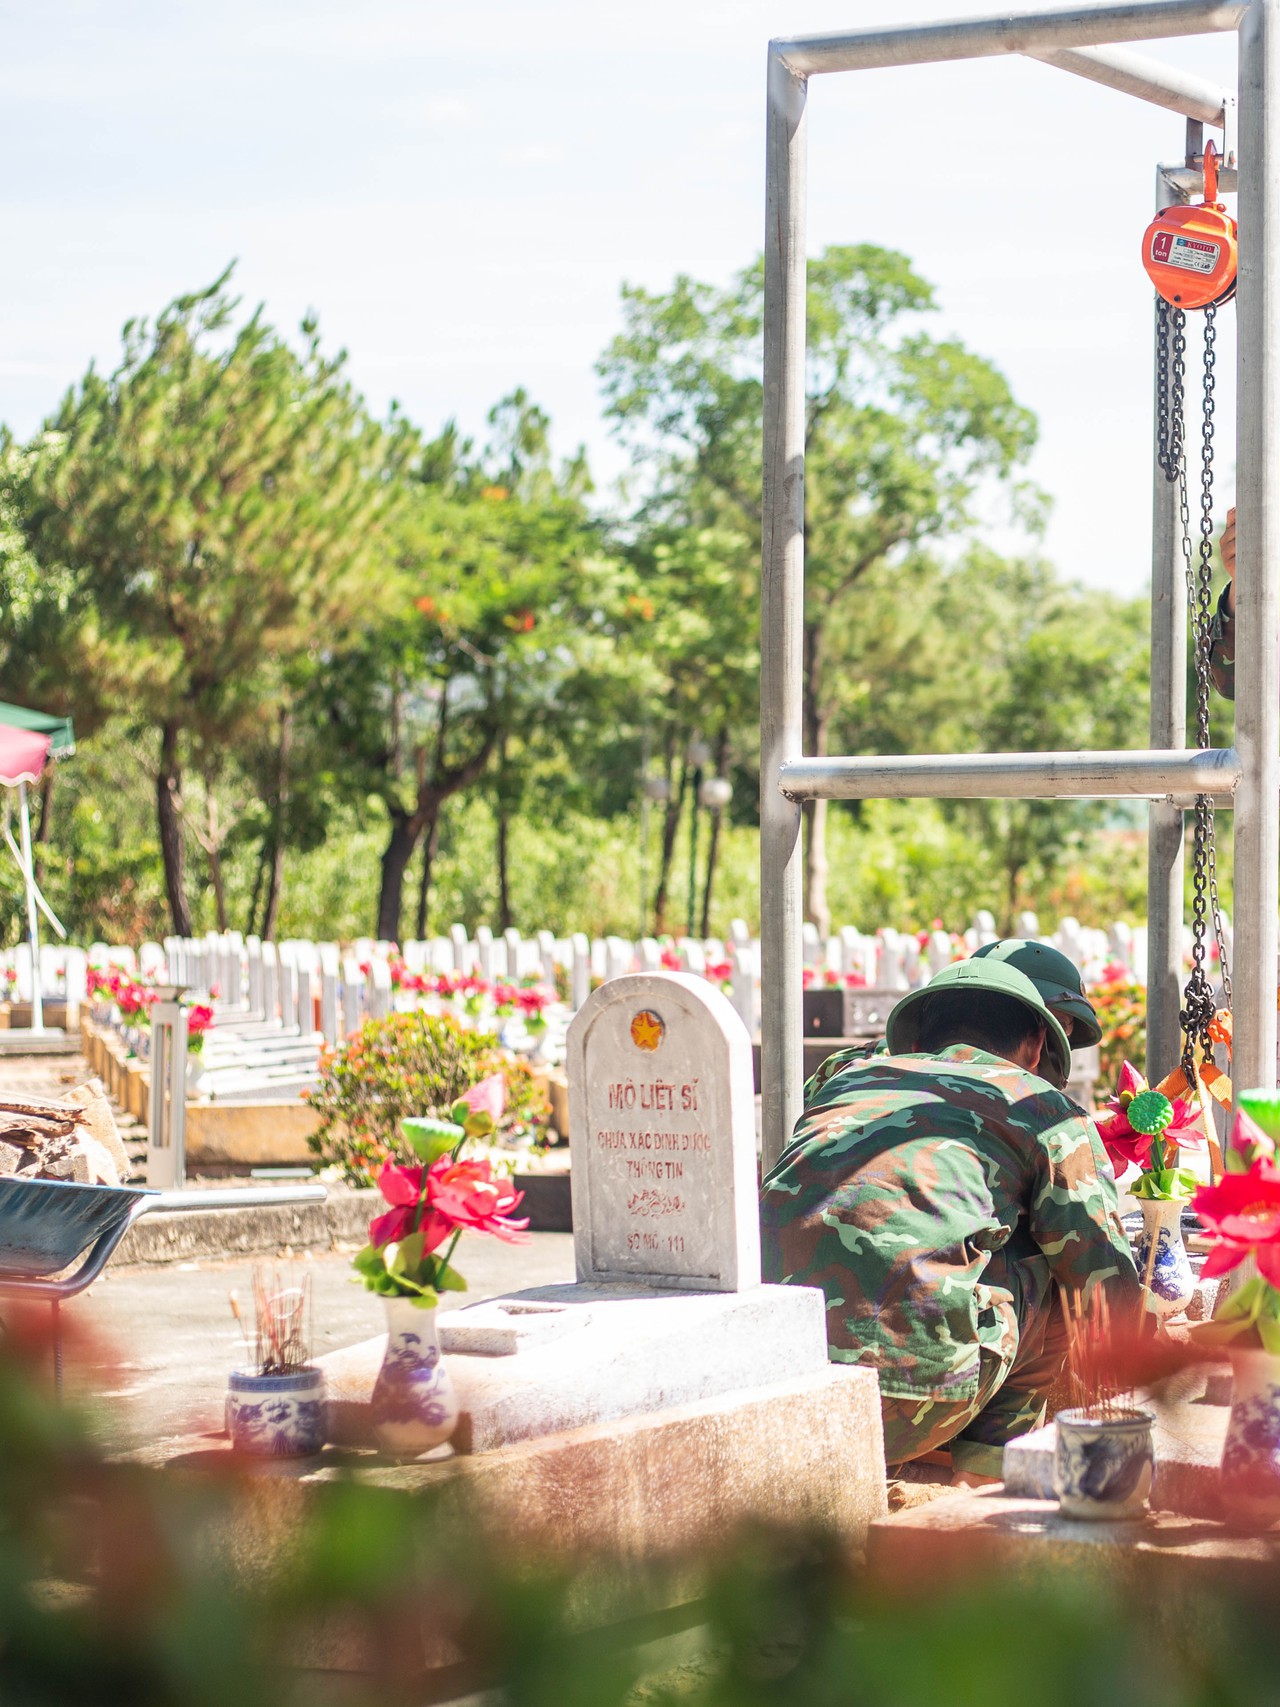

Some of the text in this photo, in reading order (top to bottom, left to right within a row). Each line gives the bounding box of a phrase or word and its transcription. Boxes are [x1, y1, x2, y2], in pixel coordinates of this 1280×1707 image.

[1155, 249, 1167, 257] ton
[665, 1161, 683, 1179] TIN
[668, 1234, 685, 1252] 111
